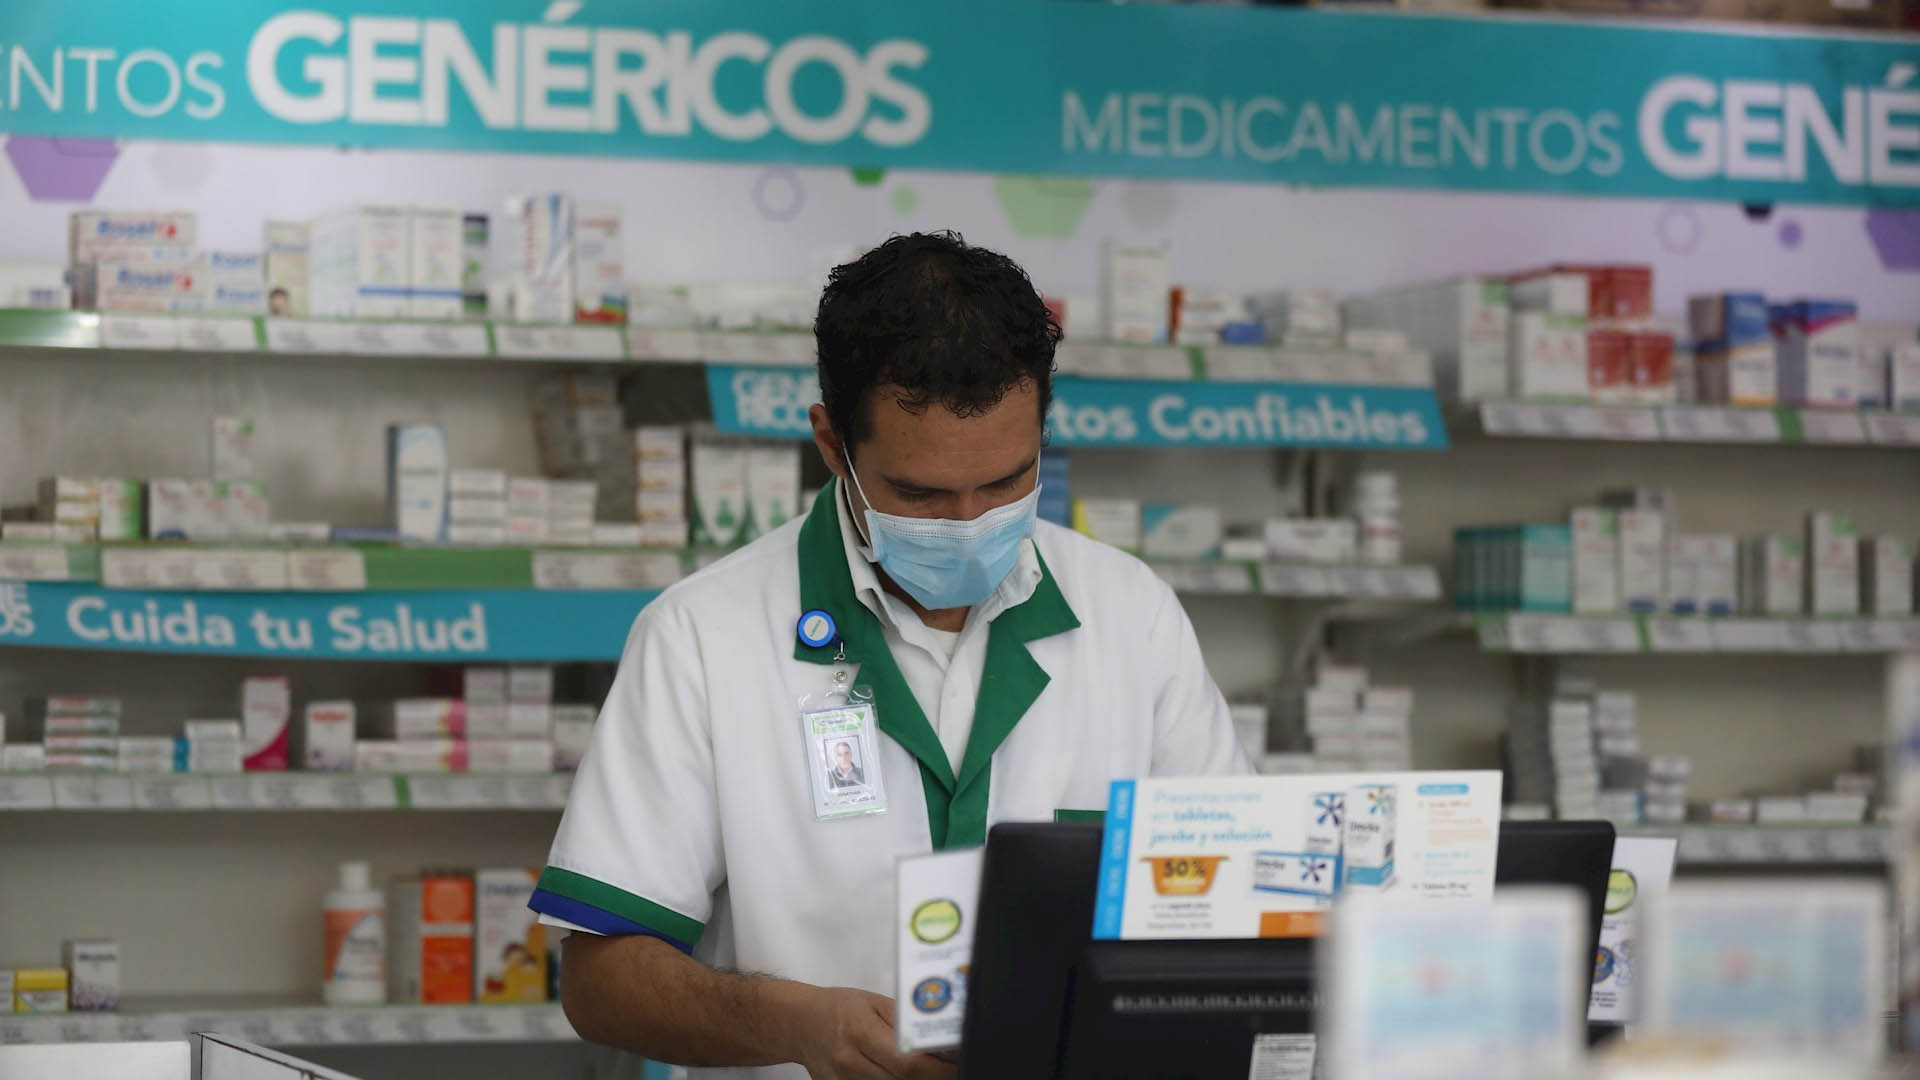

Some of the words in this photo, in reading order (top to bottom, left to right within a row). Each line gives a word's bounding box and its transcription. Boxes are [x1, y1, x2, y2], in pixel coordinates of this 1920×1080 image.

[0, 43, 227, 120] NTOS
[245, 0, 932, 148] GENÉRICOS
[1061, 91, 1625, 177] MEDICAMENTOS
[1147, 392, 1430, 444] Confiables
[66, 595, 237, 647] Cuida
[250, 608, 315, 649] tu
[328, 603, 489, 653] Salud
